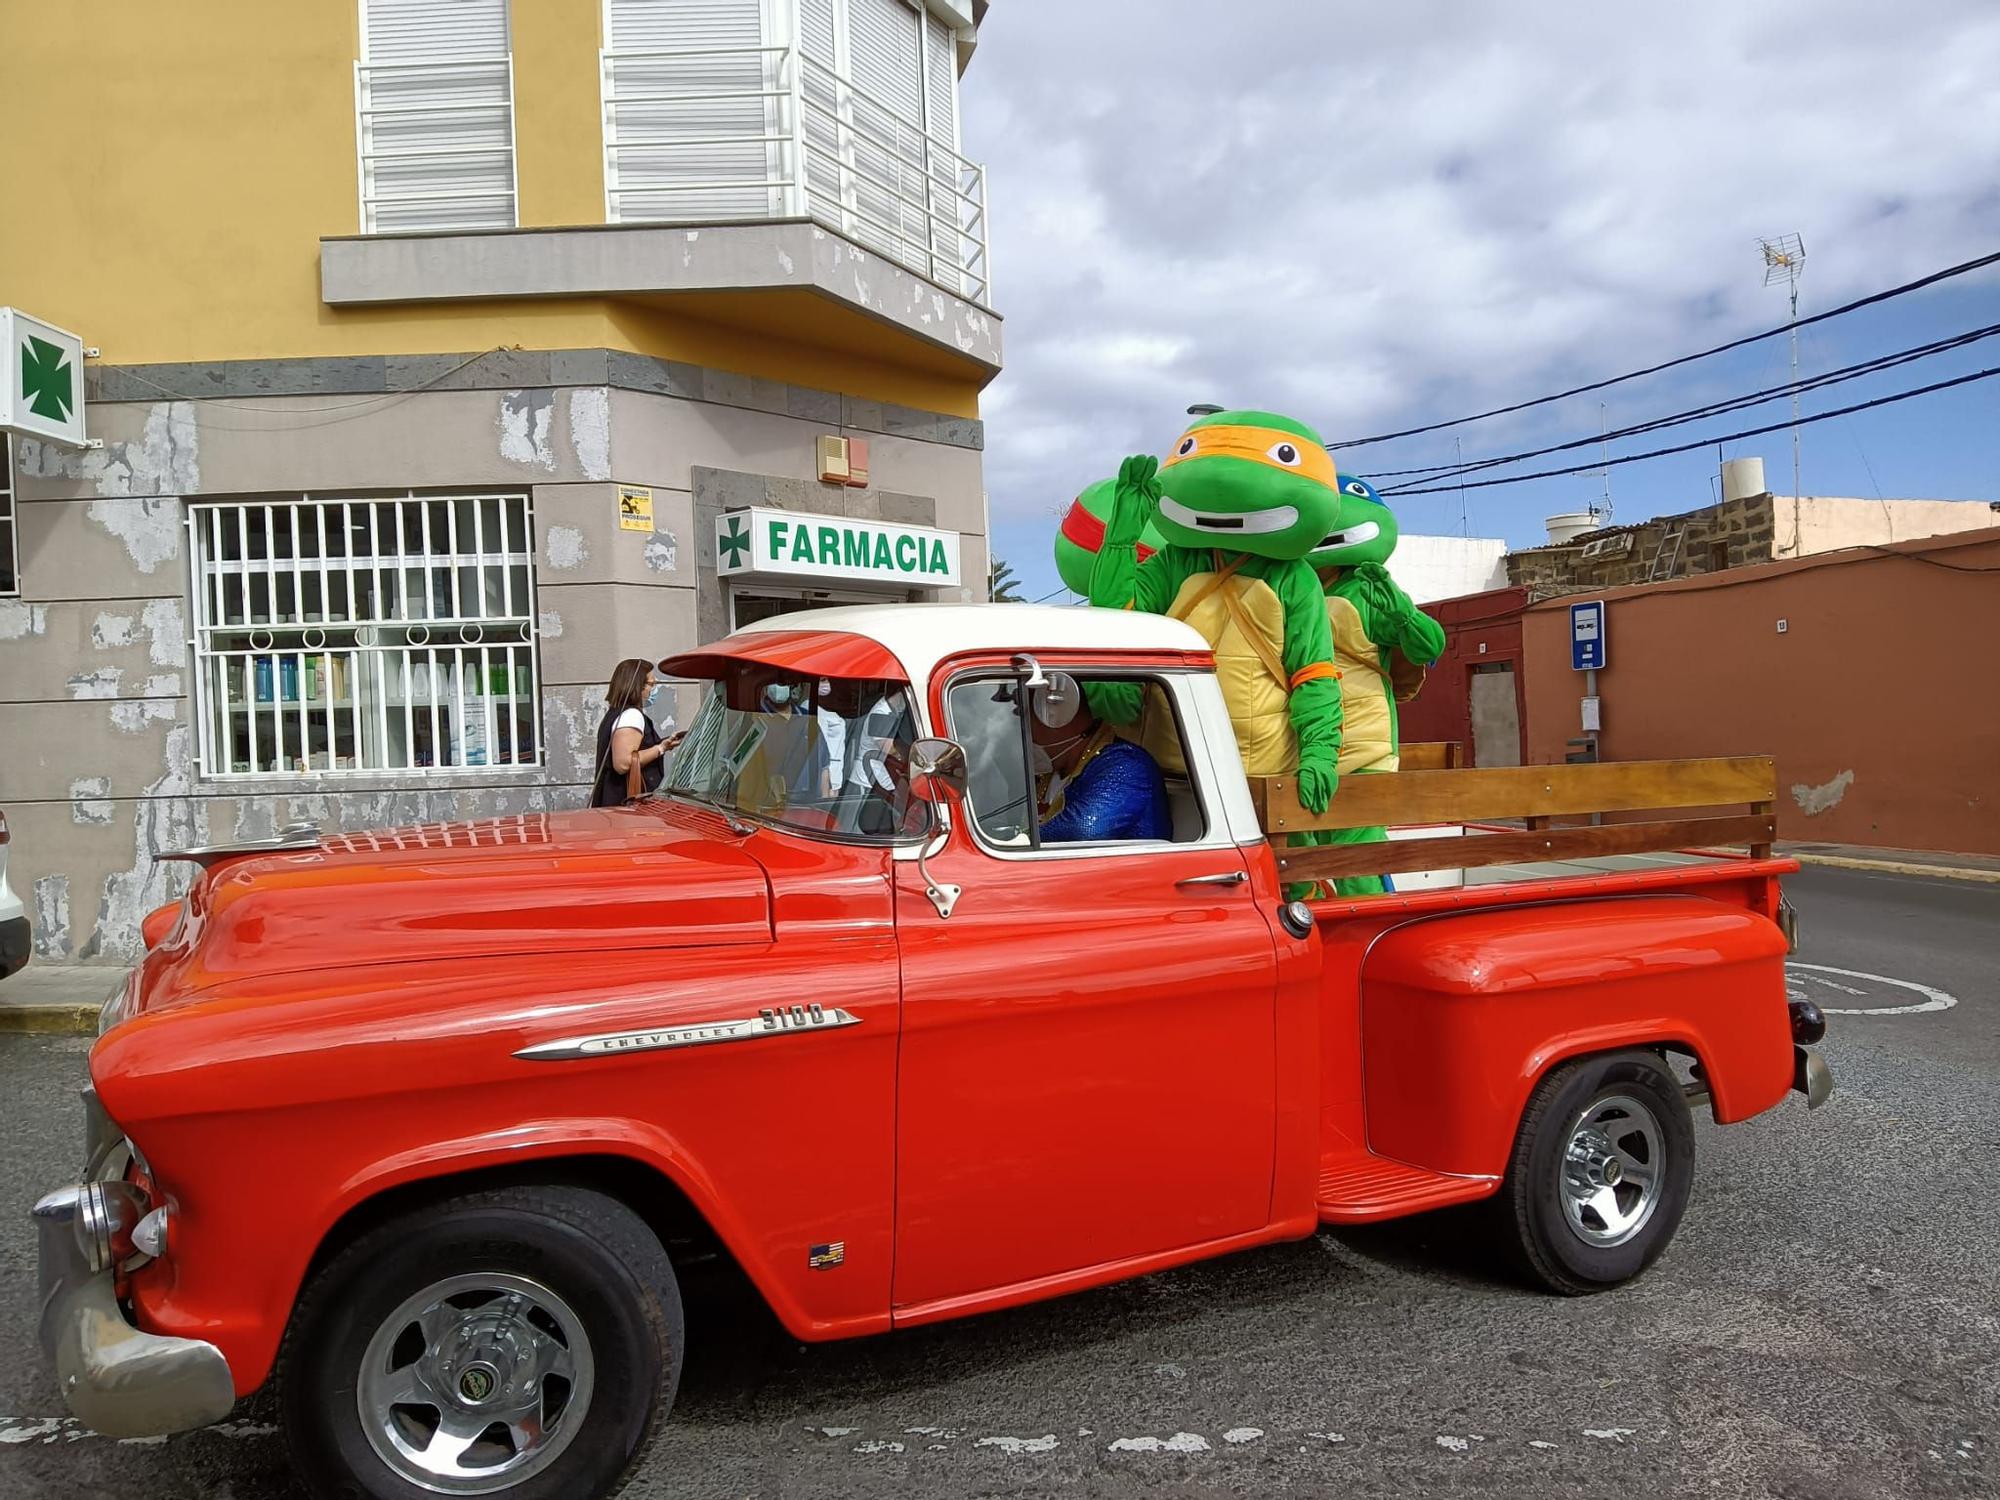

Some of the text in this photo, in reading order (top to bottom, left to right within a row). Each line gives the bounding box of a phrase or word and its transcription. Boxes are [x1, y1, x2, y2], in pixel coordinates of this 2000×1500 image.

[769, 521, 950, 575] FARMACIA
[604, 1004, 825, 1048] CHEVROLET 3100
